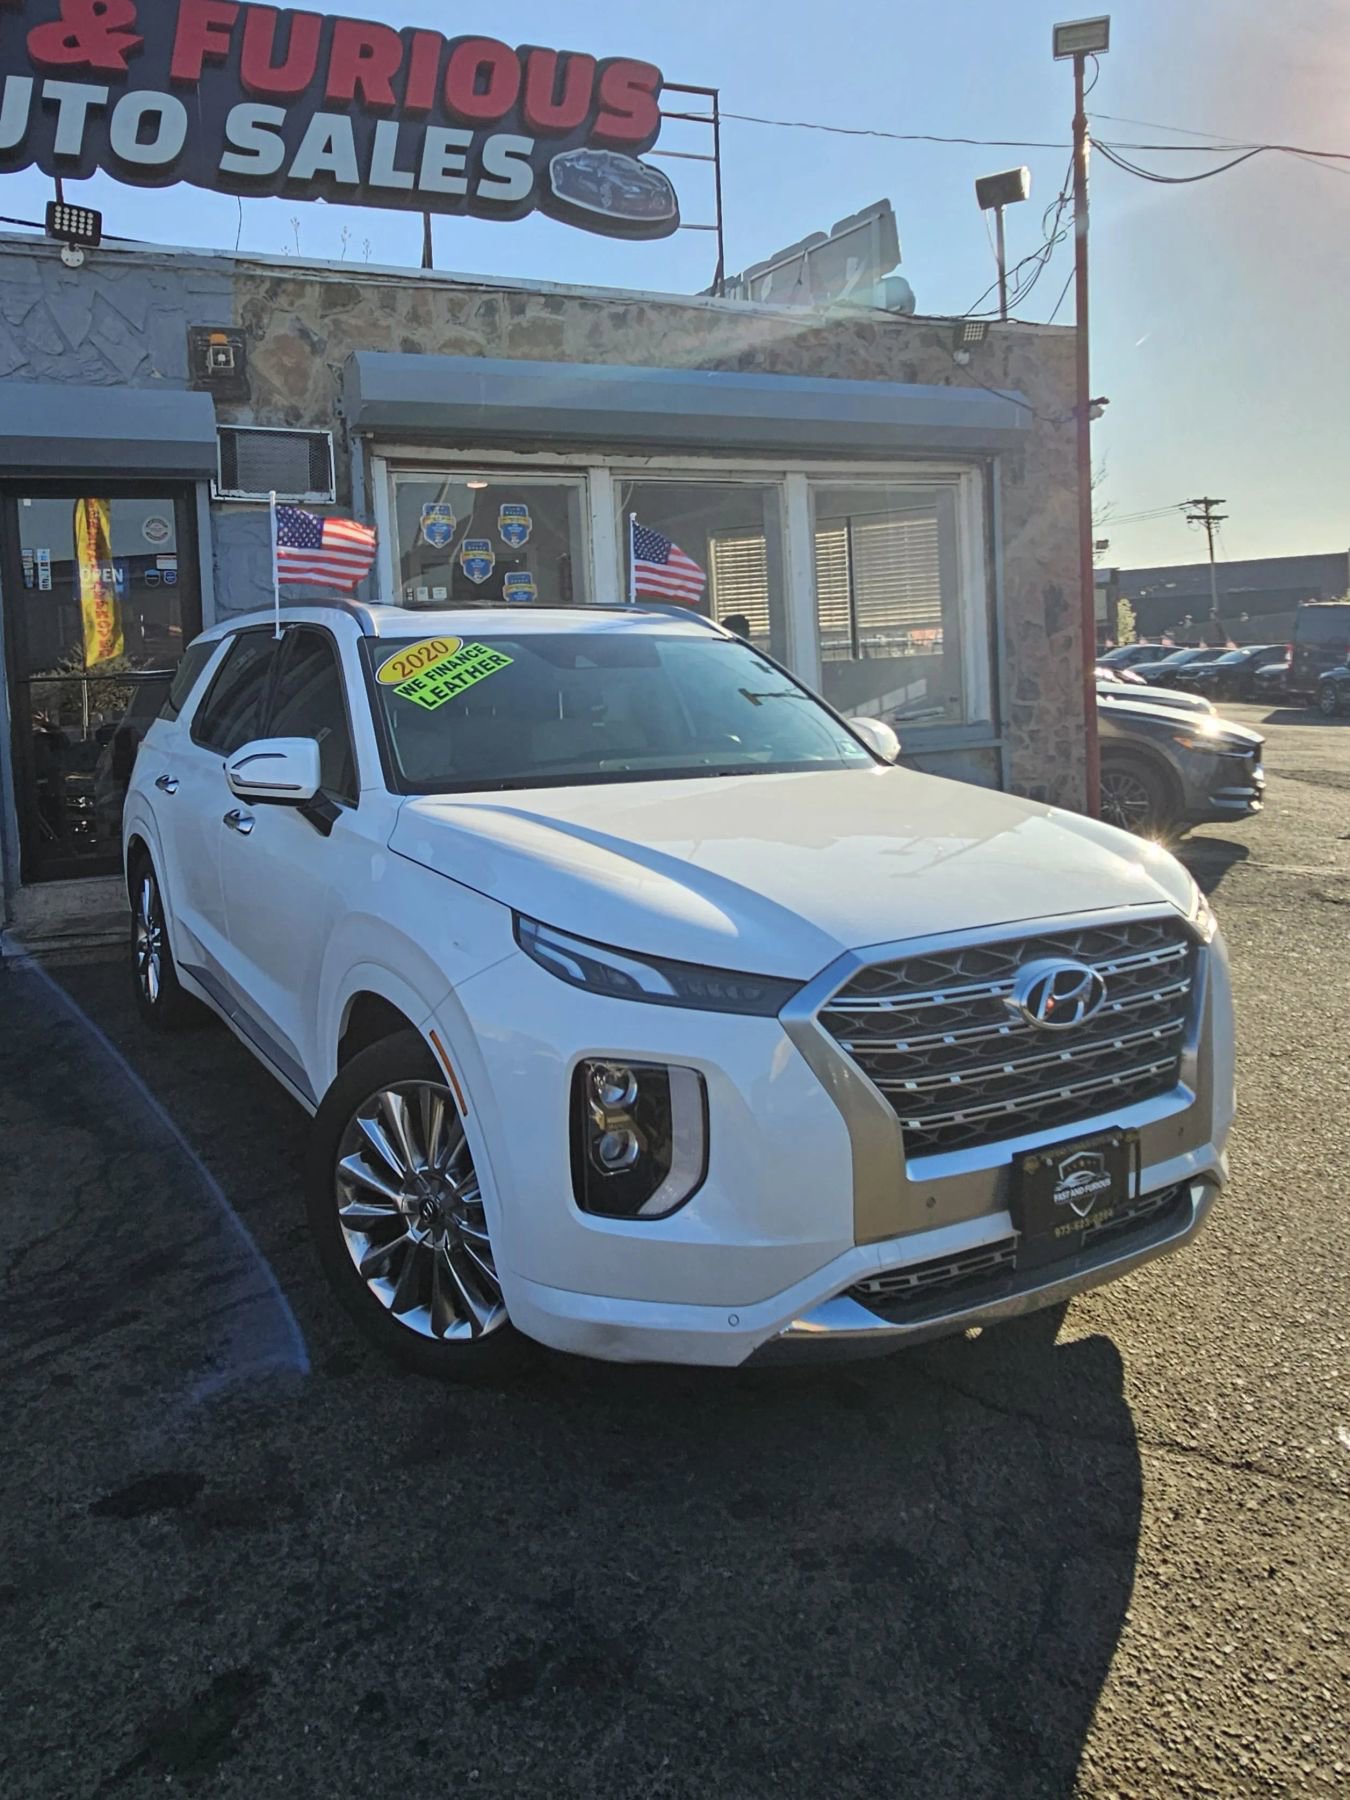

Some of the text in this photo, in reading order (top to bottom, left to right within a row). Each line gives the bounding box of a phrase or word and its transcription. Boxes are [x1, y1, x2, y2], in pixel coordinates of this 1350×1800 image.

[170, 0, 662, 144] FURIOUS
[219, 102, 535, 201] SALES
[81, 568, 123, 582] OPEN
[392, 640, 449, 678] 2020
[398, 645, 488, 697] WE FINANCE
[418, 654, 509, 707] LEATHER
